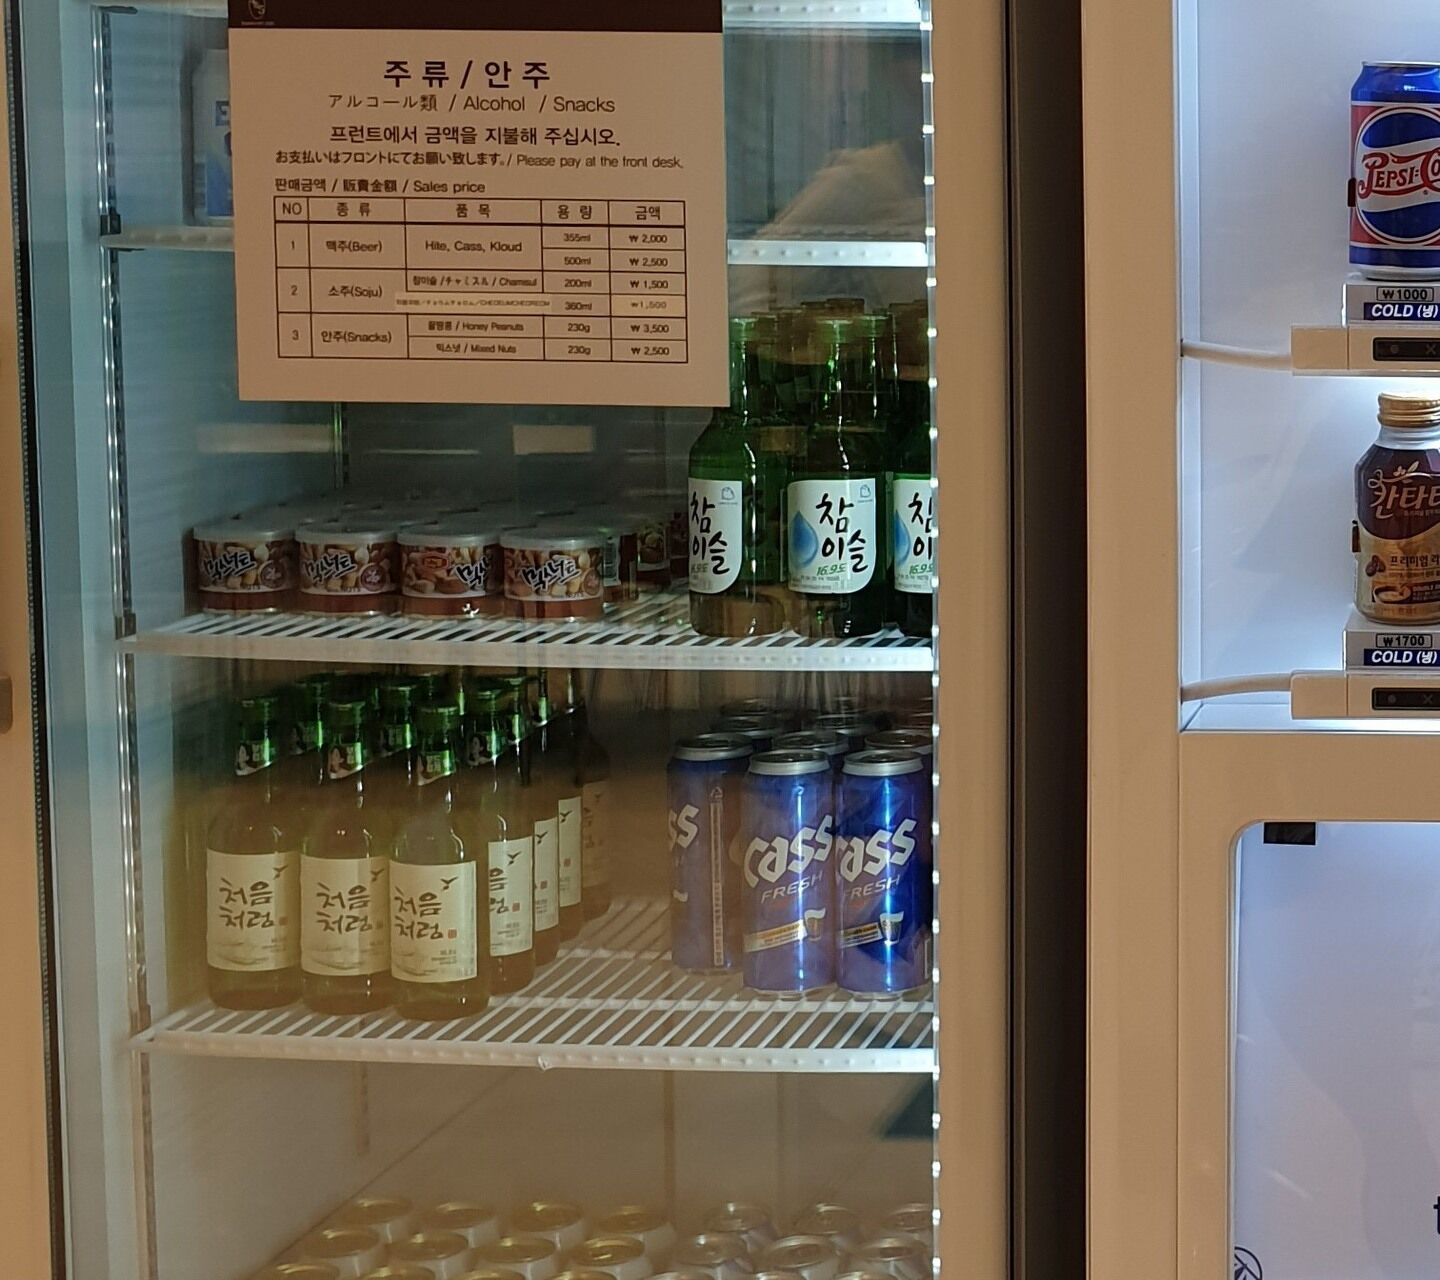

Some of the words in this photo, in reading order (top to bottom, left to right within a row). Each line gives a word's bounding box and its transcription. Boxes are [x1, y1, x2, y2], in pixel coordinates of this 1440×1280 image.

[328, 94, 437, 112] アルコール類
[463, 95, 525, 111] Alcohol
[553, 96, 616, 113] Snacks
[330, 126, 417, 144] 프런트에서
[424, 126, 478, 144] 금액을
[485, 127, 537, 145] 지불해
[544, 127, 621, 146] 주십시오.
[516, 154, 554, 166] Please
[560, 156, 581, 168] pay
[585, 155, 596, 167] at
[600, 156, 618, 167] the
[622, 156, 648, 167] front
[652, 156, 684, 168] desk.
[275, 178, 326, 192] 판매금액
[413, 180, 448, 193] Sales
[453, 181, 486, 194] price
[282, 203, 302, 215] NO
[635, 206, 661, 220] 금액
[326, 240, 383, 253] 맥주(Beer)
[490, 241, 522, 252] Kloud
[563, 233, 591, 242] 355ml
[564, 257, 591, 266] 500ml
[328, 285, 383, 299] 소주(Soju)
[321, 331, 392, 344] 안주(Snacks)
[690, 492, 715, 533] 참
[816, 493, 854, 534] 참
[692, 530, 730, 575] 이슬
[821, 529, 868, 573] 이슬
[1371, 651, 1413, 664] COLD
[219, 877, 274, 910] 처음
[316, 881, 371, 912] 처음
[761, 871, 823, 904] FRESH
[394, 885, 442, 917] 처음
[219, 906, 275, 930] 처럼
[316, 910, 373, 934] 처럼
[394, 916, 444, 940] 처럼
